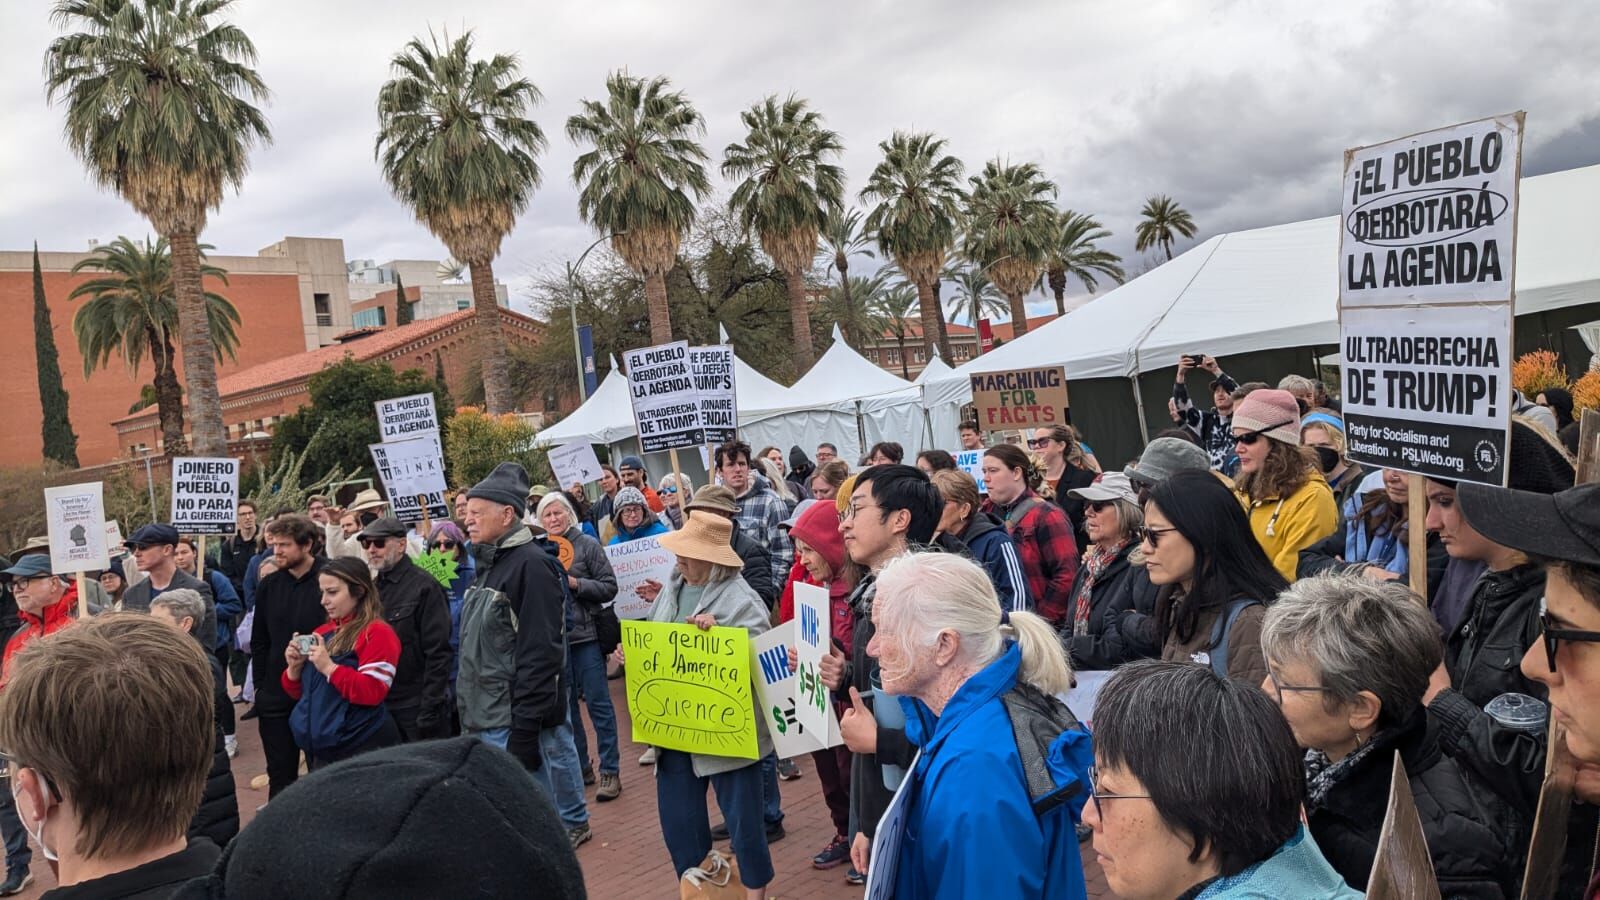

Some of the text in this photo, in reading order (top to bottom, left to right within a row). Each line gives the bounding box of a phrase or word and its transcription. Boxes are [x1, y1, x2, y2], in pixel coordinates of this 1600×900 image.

[1352, 131, 1503, 206] ¡EL PUEBLO
[1355, 181, 1495, 242] DERROTARÁ
[1347, 239, 1503, 290] LA AGENDA
[645, 346, 685, 365] PUEBLO
[689, 351, 731, 363] HE PEOPLE
[1346, 336, 1500, 368] ULTRADERECHA
[633, 360, 686, 383] DERROTARÁ
[702, 363, 731, 375] DEFEAT
[633, 377, 692, 398] LA AGENDA
[971, 369, 1060, 392] MARCHING
[999, 390, 1037, 406] FOR
[1347, 368, 1498, 418] DE TRUMP!
[397, 397, 430, 412] PUEBLO
[637, 402, 697, 421] ULTRADERECHA
[987, 405, 1055, 424] FACTS
[384, 407, 431, 424] DERROTARÁ
[640, 413, 700, 434] DE TRUMP!
[701, 411, 732, 426] ENDA!
[384, 419, 435, 436] LA AGENDA
[1349, 422, 1450, 448] Party for Socialism and
[1350, 438, 1389, 457] Liberation
[1401, 447, 1464, 473] PSLWeb.org
[178, 462, 234, 477] ¡DINERO
[176, 481, 234, 497] PUEBLO,
[176, 498, 233, 510] NO PARA
[175, 511, 234, 521] LA GUERRA!
[610, 545, 634, 557] KNOW
[801, 603, 820, 648] NIH:
[624, 627, 653, 649] The
[643, 650, 739, 682] of America
[646, 682, 737, 728] Science
